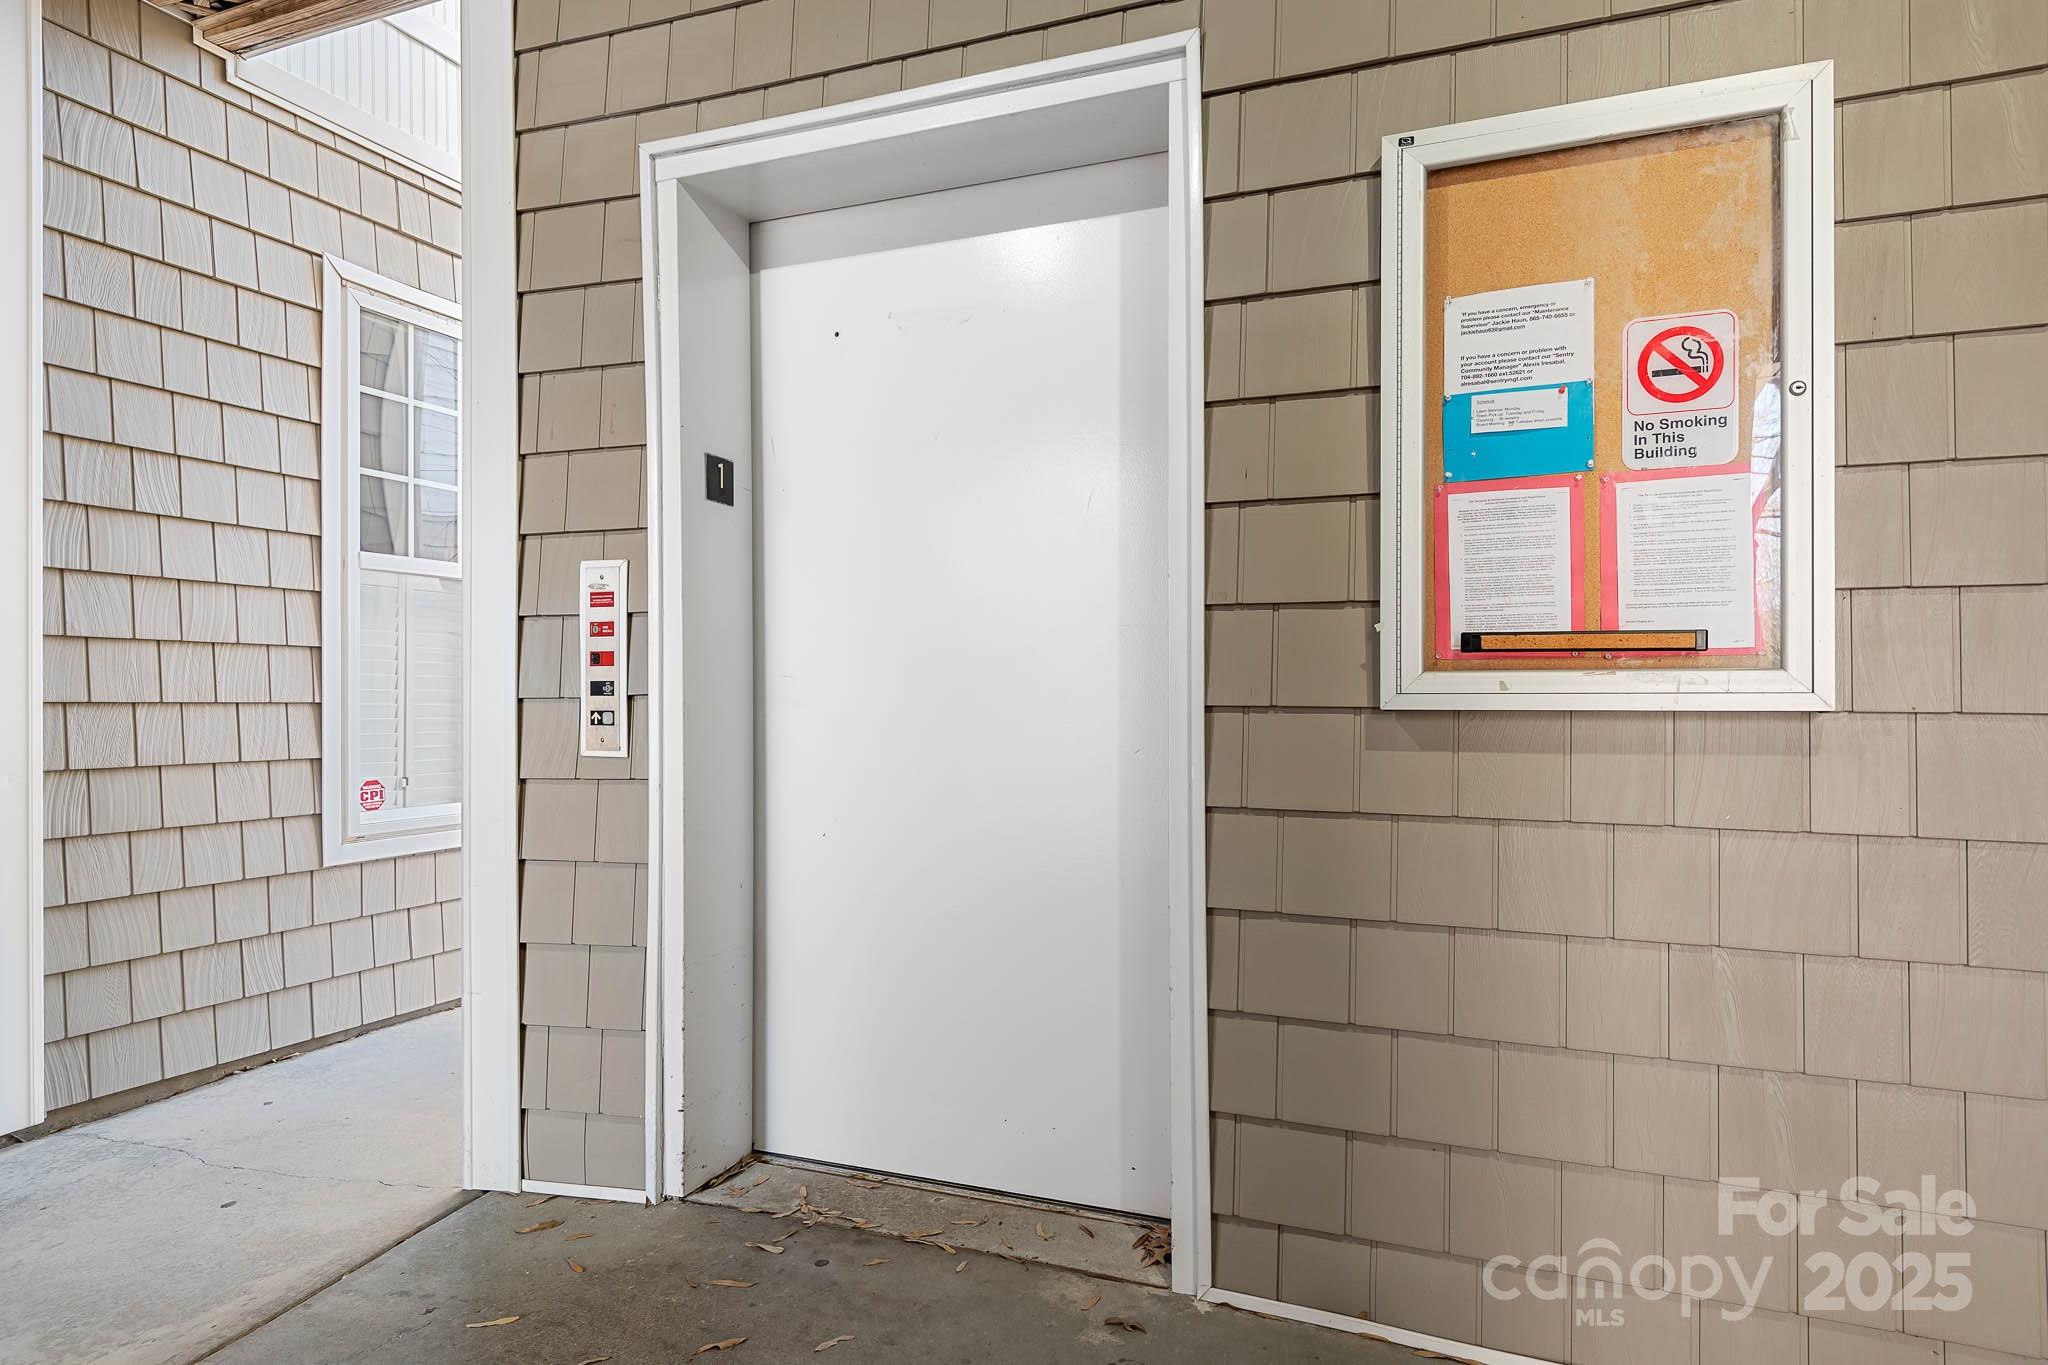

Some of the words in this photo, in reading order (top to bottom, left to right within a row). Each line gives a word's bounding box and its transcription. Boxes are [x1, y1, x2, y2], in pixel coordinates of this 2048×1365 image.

[1635, 421, 1655, 431] No
[1660, 415, 1728, 430] Smoking
[1635, 435, 1647, 445] In
[1652, 432, 1685, 444] This
[1635, 446, 1698, 459] Building
[718, 463, 724, 488] 1
[361, 790, 384, 801] CPI
